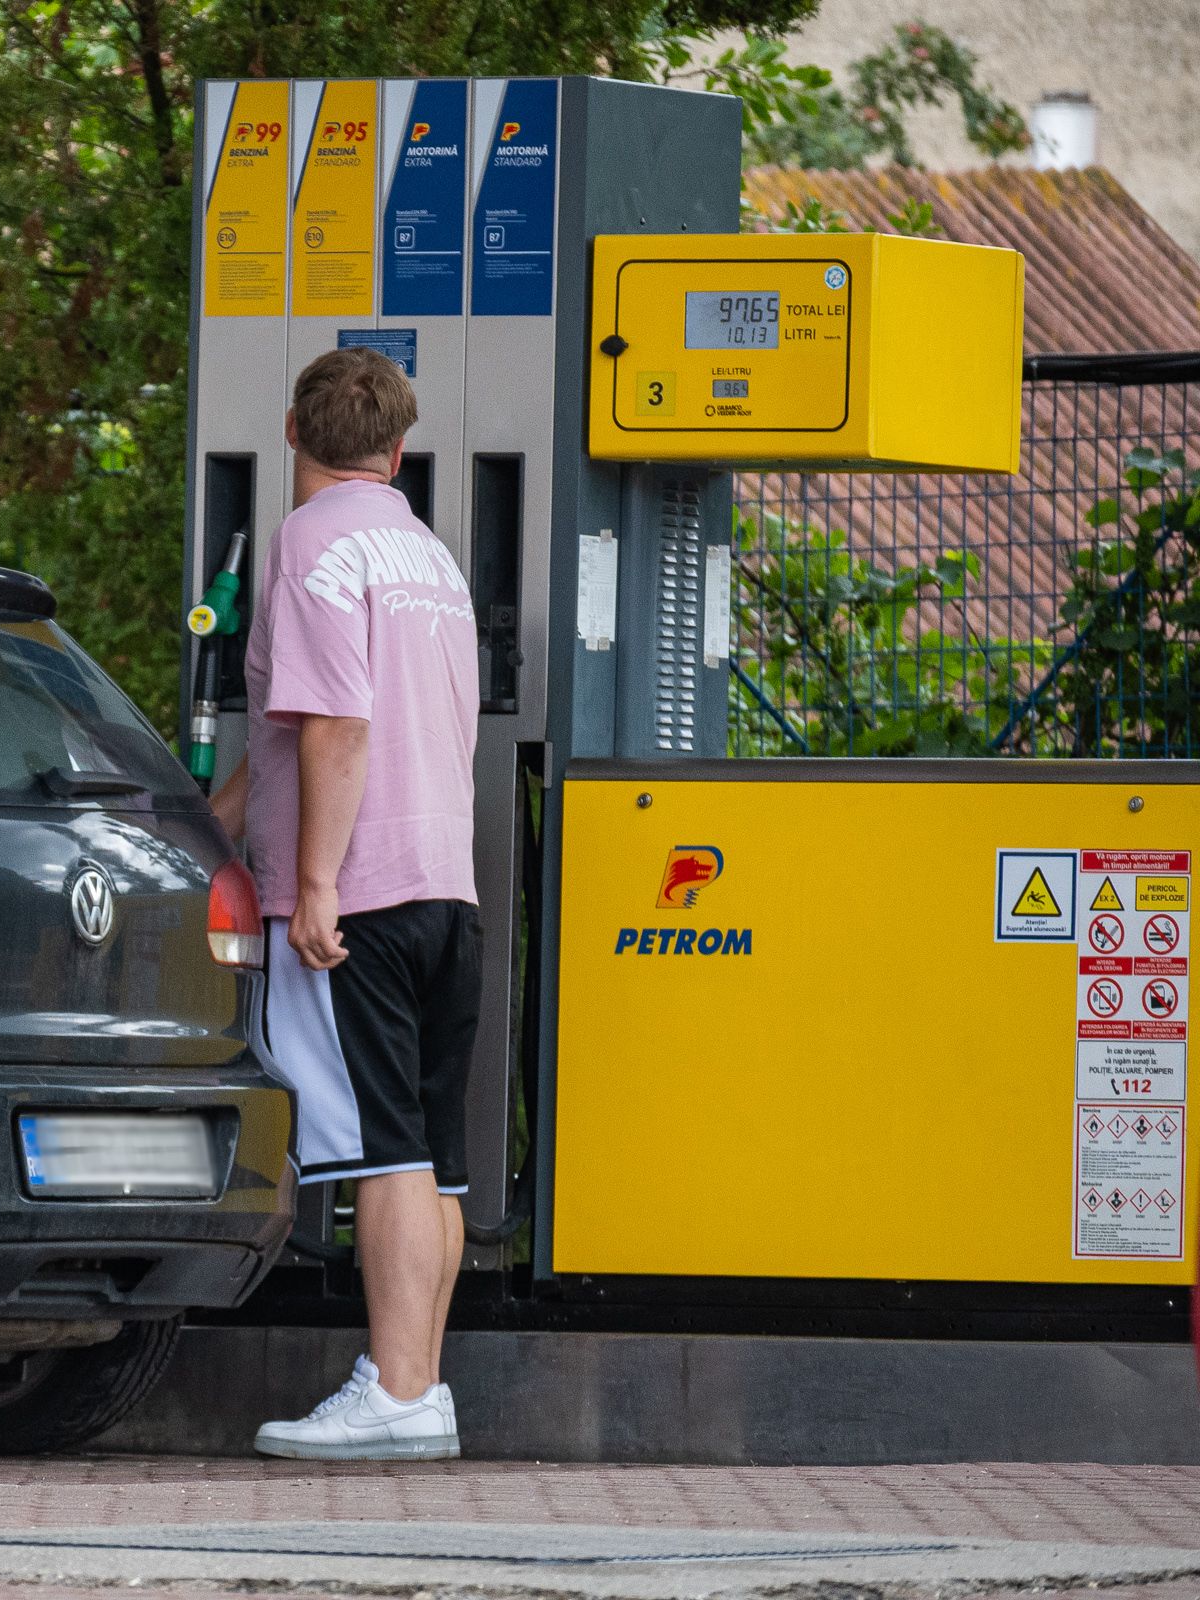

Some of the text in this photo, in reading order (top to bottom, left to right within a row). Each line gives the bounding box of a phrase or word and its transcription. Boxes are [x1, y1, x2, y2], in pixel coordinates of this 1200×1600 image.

[256, 122, 282, 143] 99
[343, 121, 369, 142] 95
[229, 146, 269, 157] BENZINĂ
[317, 145, 357, 156] BENZINĂ
[406, 144, 458, 156] MOTORINĂ
[496, 144, 549, 156] MOTORINĂ
[227, 159, 254, 168] EXTRA
[314, 158, 361, 167] STANDARD
[404, 158, 432, 167] EXTRA
[494, 157, 542, 166] STANDARD
[219, 233, 234, 242] E10
[307, 232, 321, 241] E10
[786, 304, 846, 316] TOTAL LEI
[785, 328, 816, 340] LITRI
[712, 367, 752, 375] LEI/LITRU
[648, 381, 664, 406] 3
[1096, 853, 1106, 861] Vă
[1107, 853, 1129, 862] rugăm,
[1130, 854, 1148, 862] opriți
[1111, 862, 1132, 871] timpul
[1147, 885, 1178, 893] PERICOL
[1140, 894, 1185, 902] DE EXPLOZIE
[614, 928, 753, 956] PETROM
[1106, 1046, 1112, 1055] În
[1113, 1058, 1131, 1066] rugăm
[1132, 1058, 1150, 1066] sunați
[1089, 1067, 1174, 1076] POLIȚIE, SALVARE, POMPIERI
[1122, 1079, 1152, 1093] 112
[413, 1445, 427, 1453] AIR
